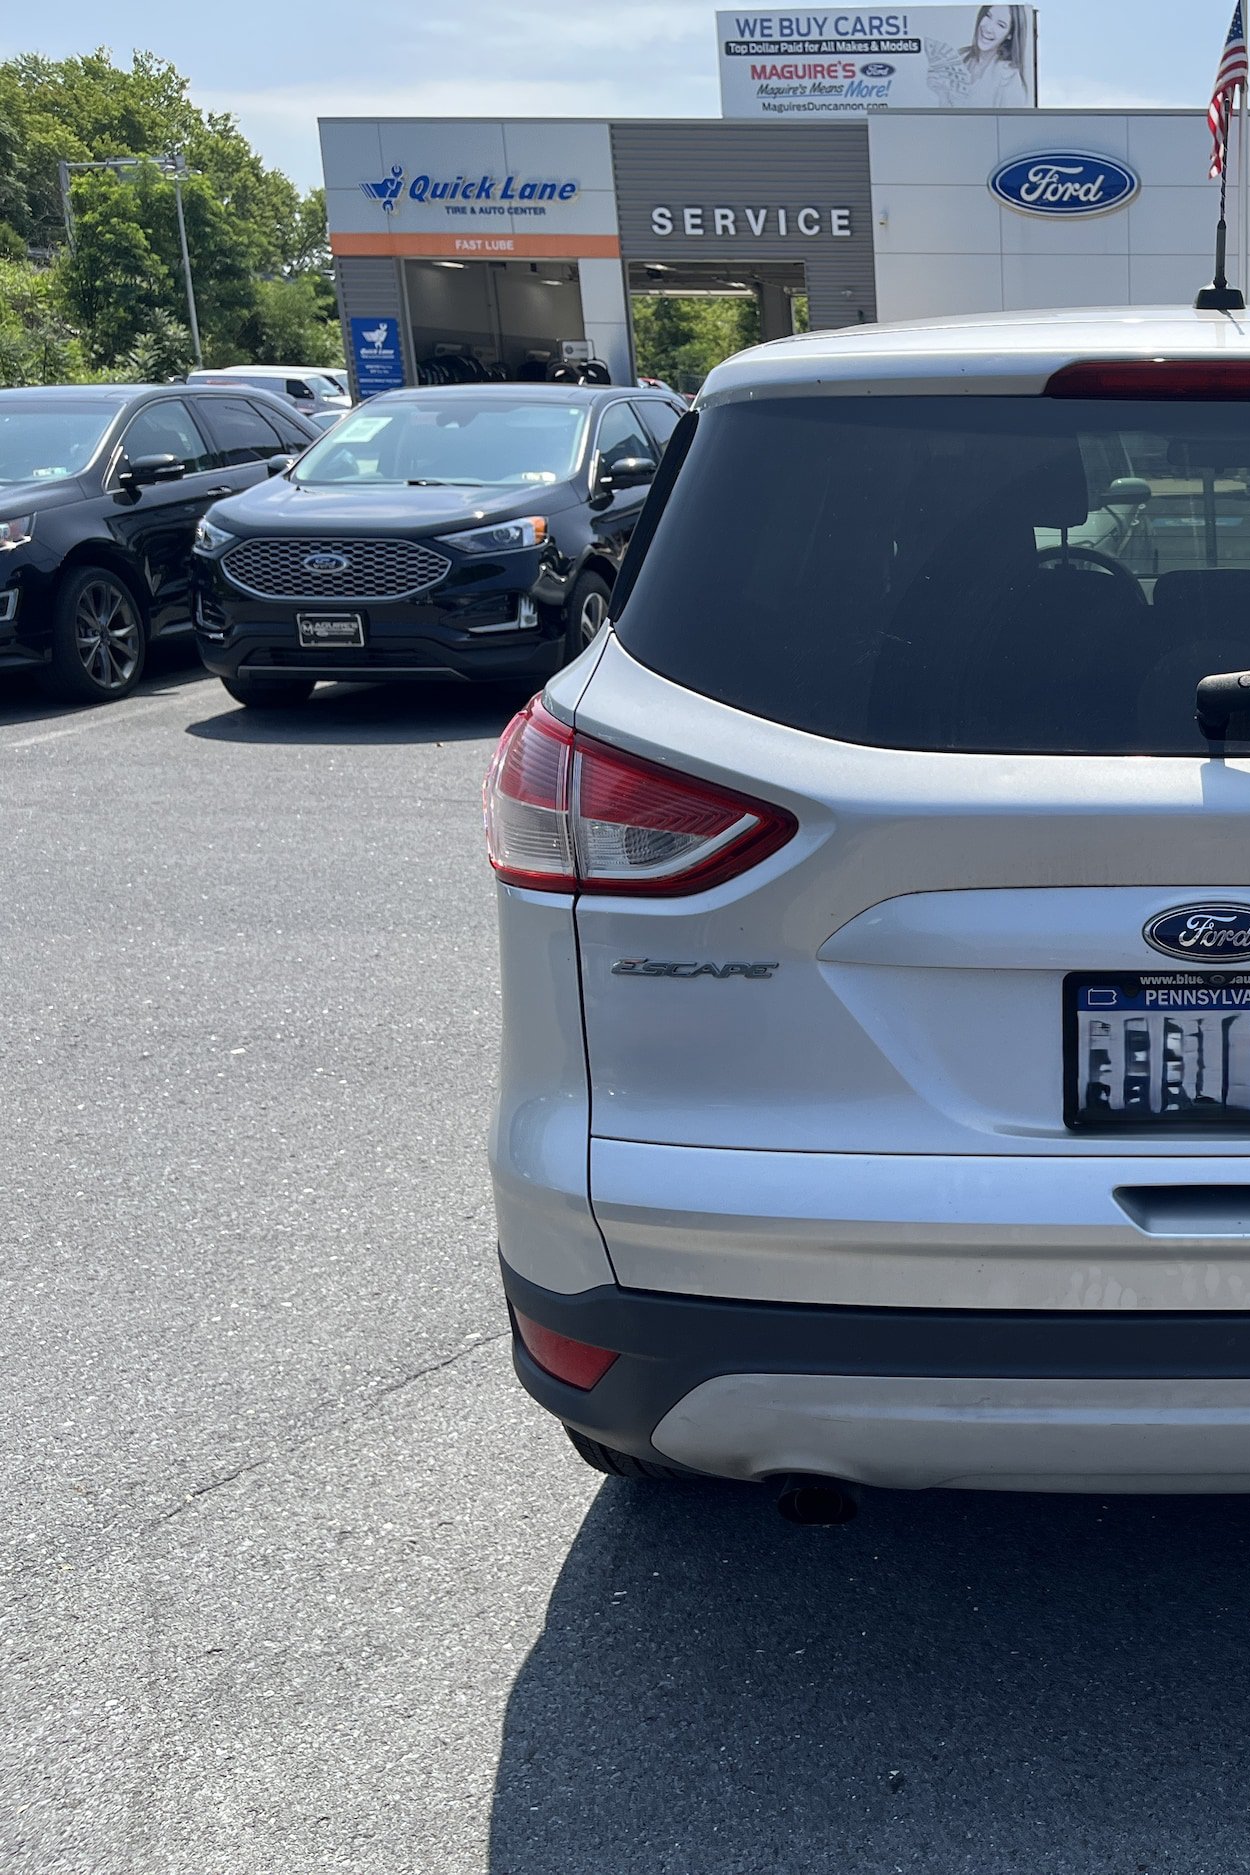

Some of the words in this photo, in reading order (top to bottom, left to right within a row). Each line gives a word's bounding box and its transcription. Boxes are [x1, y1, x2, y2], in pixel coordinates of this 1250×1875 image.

[735, 18, 773, 38] WE
[779, 17, 829, 37] BUY
[833, 16, 908, 36] CARS!
[729, 43, 747, 55] Top
[750, 43, 779, 54] Dollar
[781, 42, 804, 53] Paid
[805, 41, 819, 52] for
[821, 40, 834, 52] All
[836, 40, 869, 51] Makes
[871, 40, 878, 50] &
[881, 39, 918, 51] Models
[751, 62, 856, 80] MAGUIRE'S
[865, 65, 889, 76] Ford
[757, 83, 807, 99] Maguire's
[810, 82, 844, 95] Means
[845, 80, 892, 98] More!
[409, 175, 494, 202] Quick
[501, 176, 576, 200] Lane
[1020, 165, 1105, 201] Ford
[446, 206, 467, 215] TIRE
[479, 207, 503, 215] AUTO
[507, 206, 546, 215] CENTER
[652, 207, 851, 236] SERVICE
[455, 240, 481, 250] FAST
[485, 241, 514, 250] LUBE
[611, 957, 780, 980] ESCAPE
